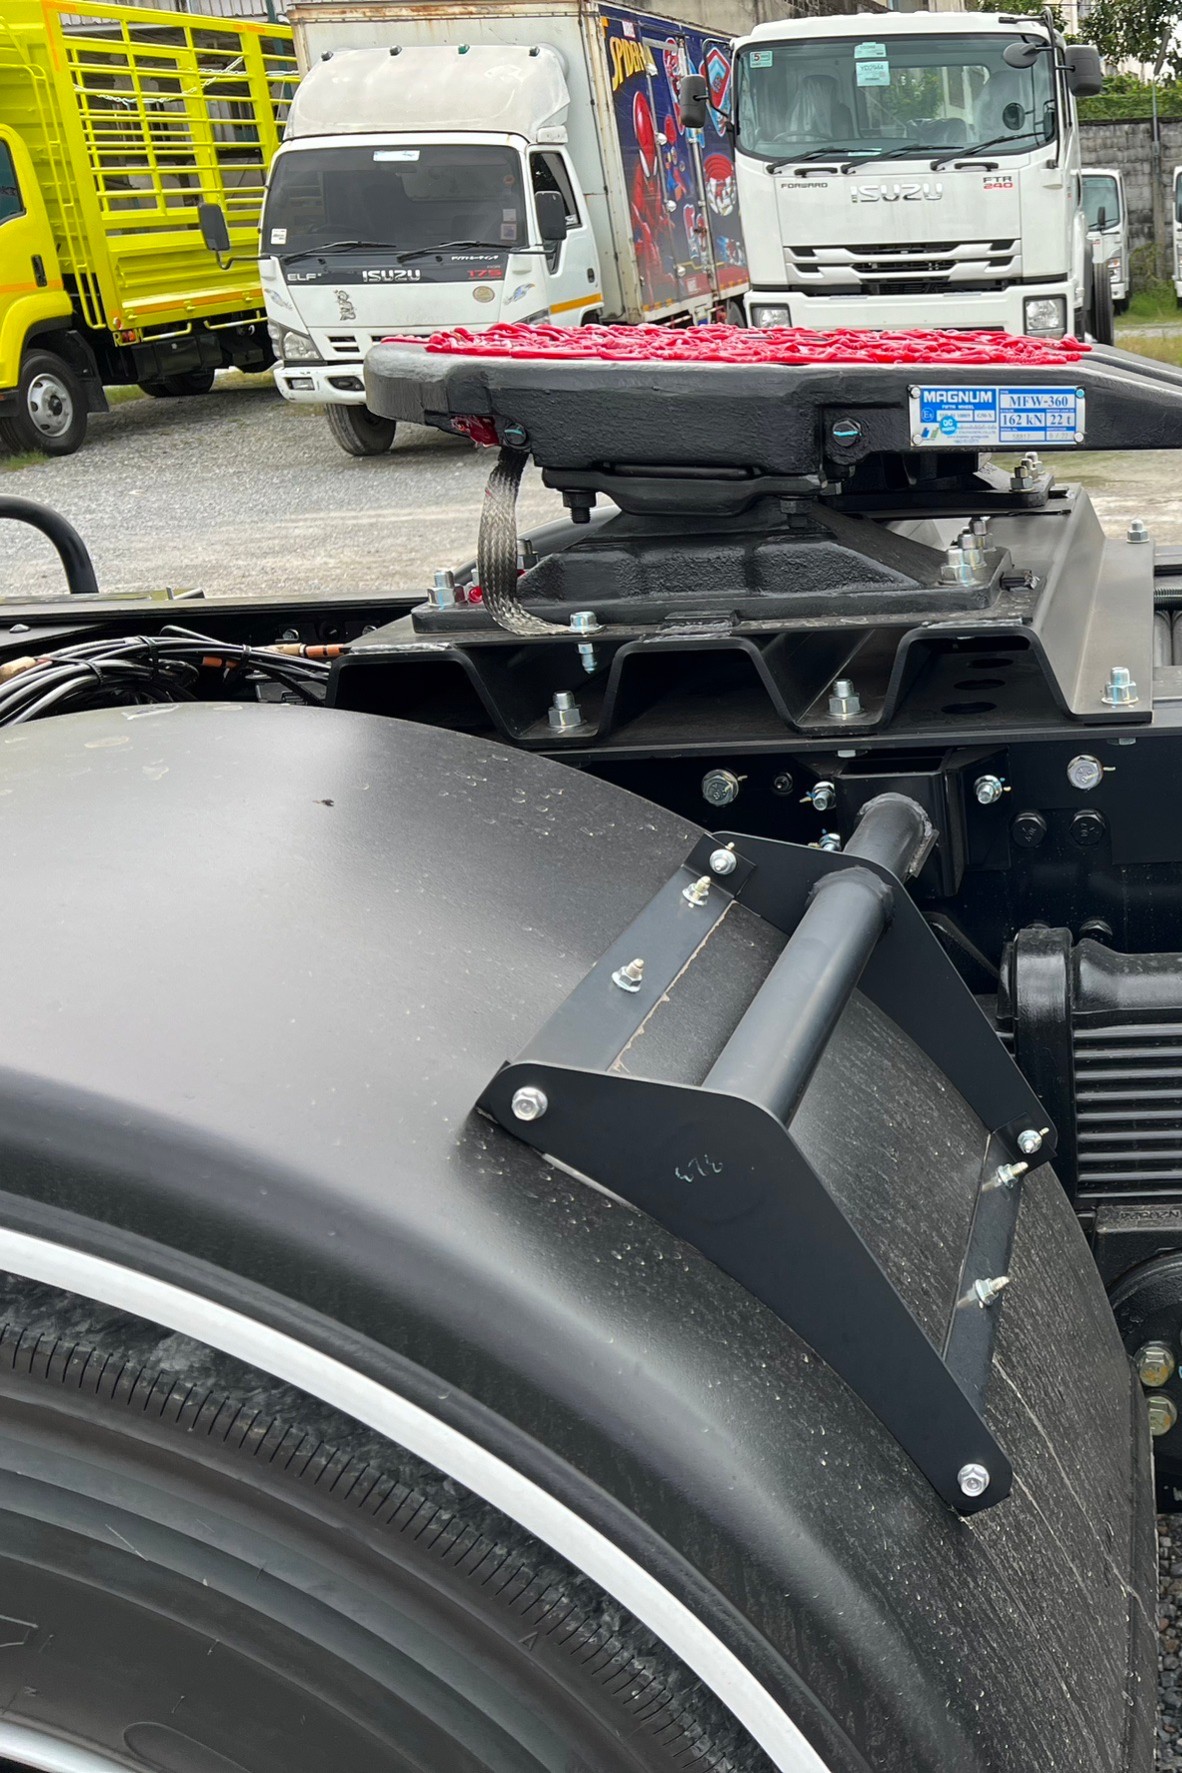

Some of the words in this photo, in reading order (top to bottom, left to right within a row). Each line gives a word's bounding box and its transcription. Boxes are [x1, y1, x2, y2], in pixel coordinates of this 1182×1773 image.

[982, 175, 1012, 183] FTR
[982, 182, 1013, 190] 240
[850, 182, 943, 203] ISUZU
[286, 272, 317, 282] ELF
[362, 269, 421, 283] ISUZU
[924, 390, 992, 403] MAGNUM
[1009, 395, 1069, 407] MFW-360
[1003, 414, 1022, 426] 162
[1026, 414, 1043, 426] kN
[1050, 414, 1063, 425] 22
[1066, 415, 1071, 425] t
